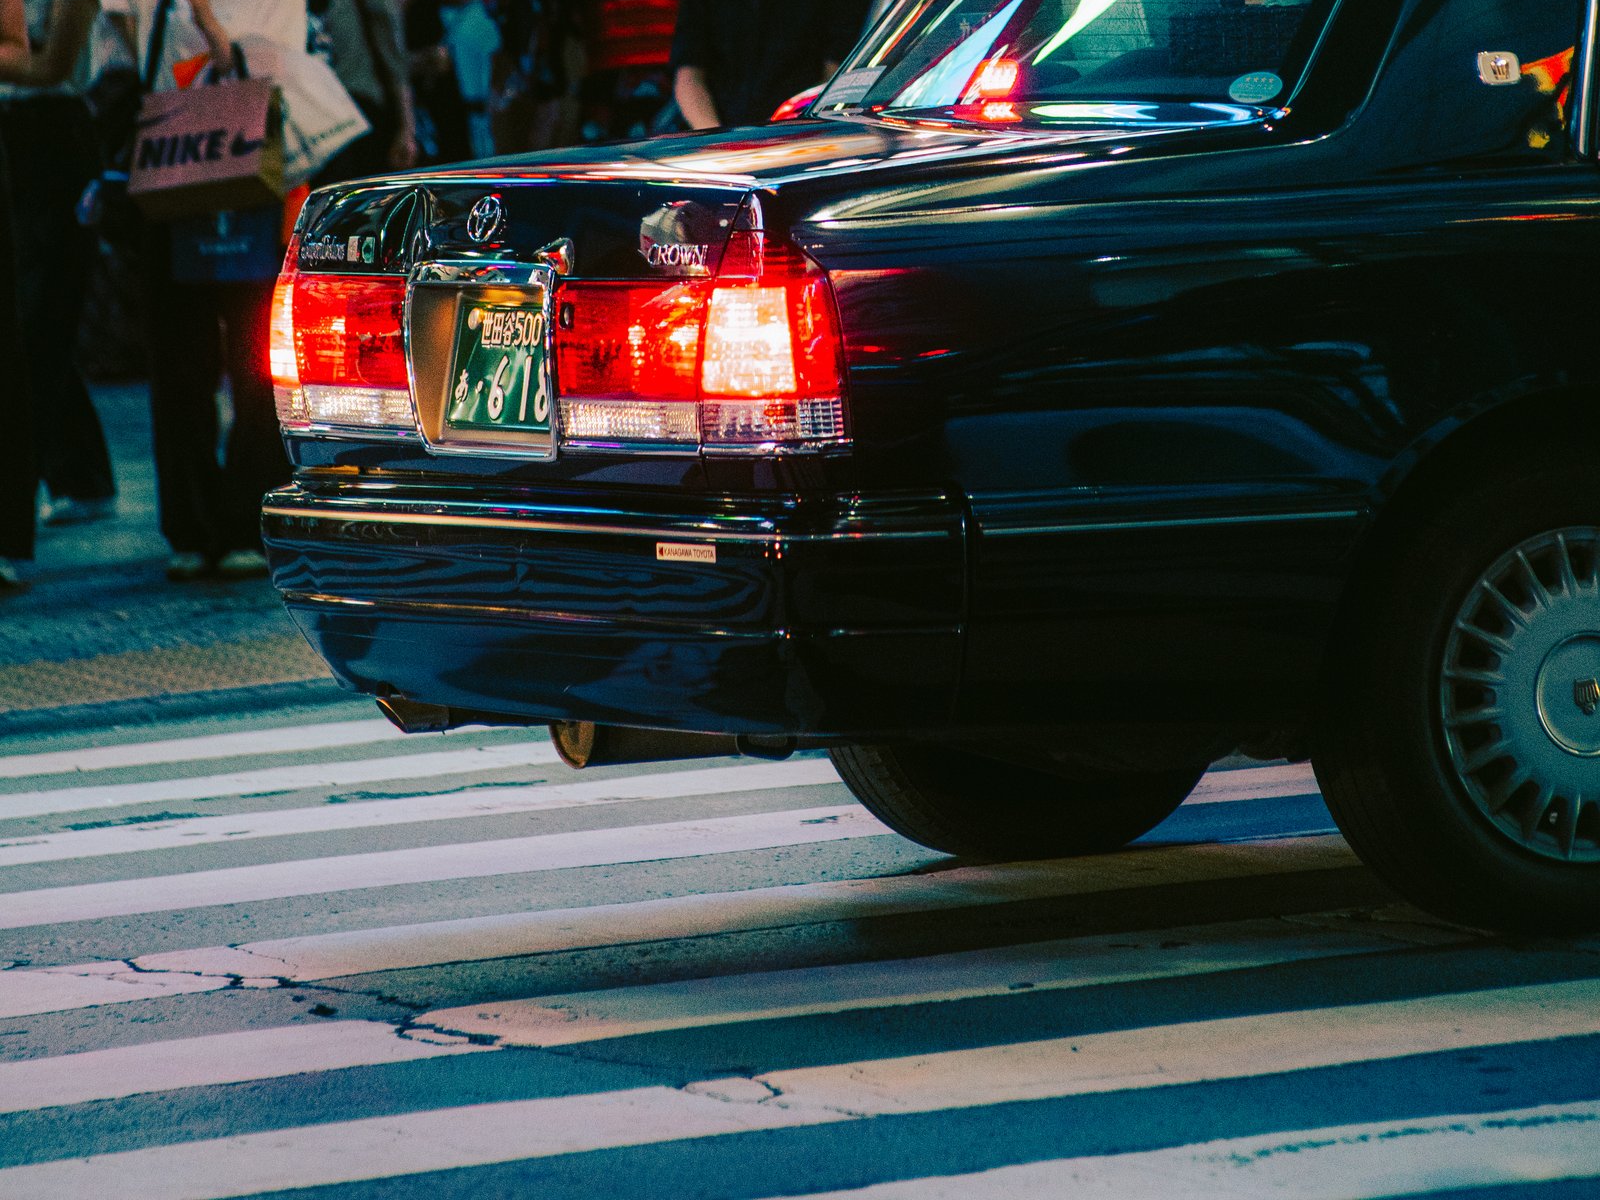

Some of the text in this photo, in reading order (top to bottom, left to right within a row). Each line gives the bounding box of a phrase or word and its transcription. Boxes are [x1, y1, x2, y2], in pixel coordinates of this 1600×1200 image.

[138, 128, 228, 169] NIKE
[647, 243, 708, 267] CROWN
[664, 547, 715, 559] KANAGAWA TOYOTA
